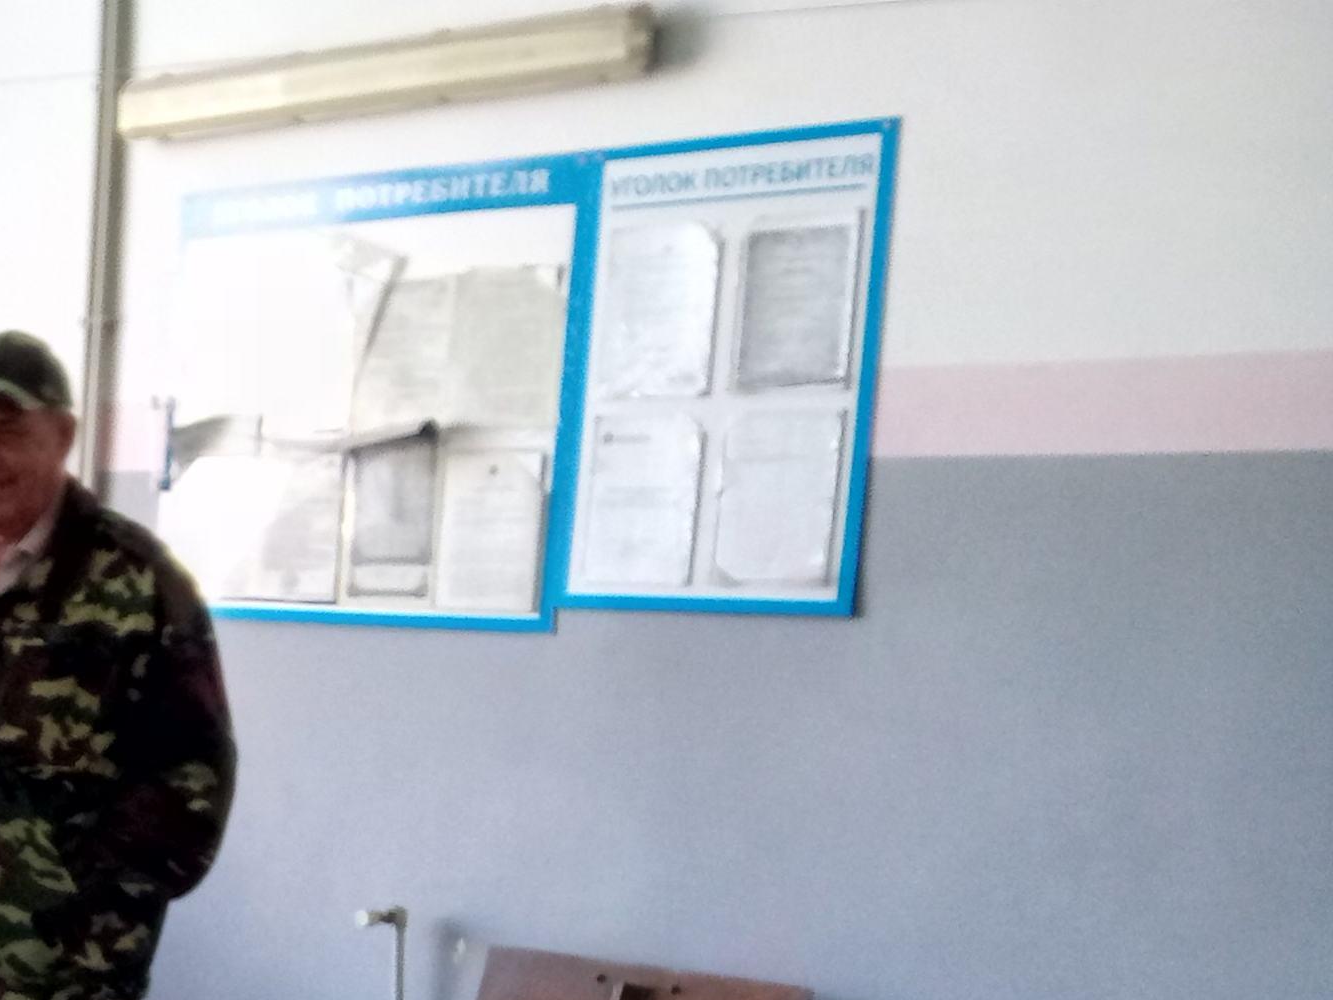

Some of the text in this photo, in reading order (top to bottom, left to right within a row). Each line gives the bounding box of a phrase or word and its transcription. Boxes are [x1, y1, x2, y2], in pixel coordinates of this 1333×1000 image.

[335, 168, 550, 211] ПОТРЕБИТЕЛЯ
[611, 152, 875, 197] УГОЛОК ПОТРЕБИТЕЛЯ
